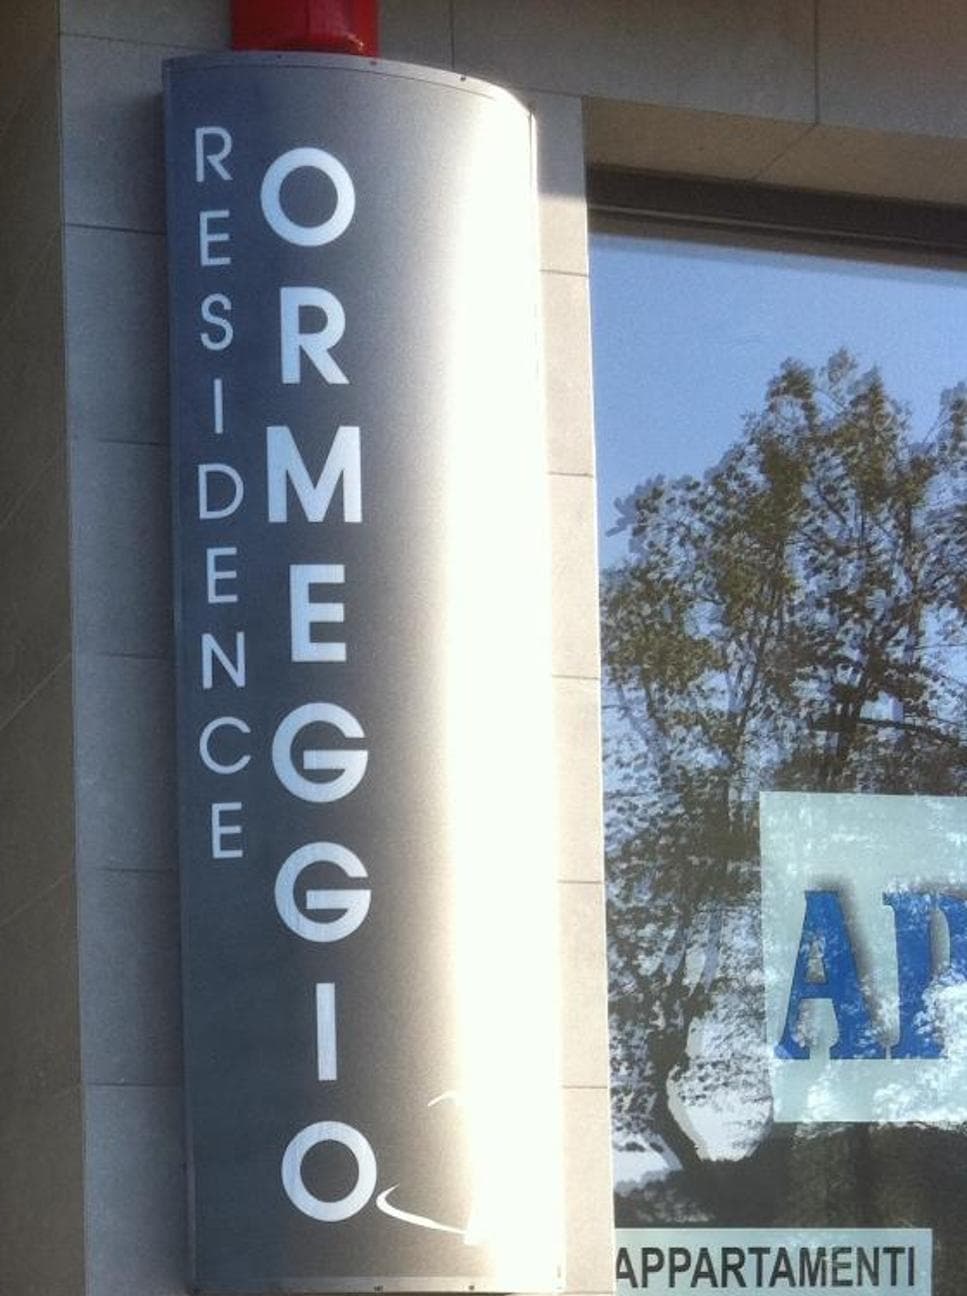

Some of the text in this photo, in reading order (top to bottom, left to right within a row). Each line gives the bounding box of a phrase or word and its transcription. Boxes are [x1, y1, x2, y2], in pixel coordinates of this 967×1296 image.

[194, 126, 252, 859] RESIDENCE
[260, 146, 378, 1223] ORMEGGIO
[616, 1246, 916, 1288] APPARTAMENTI
